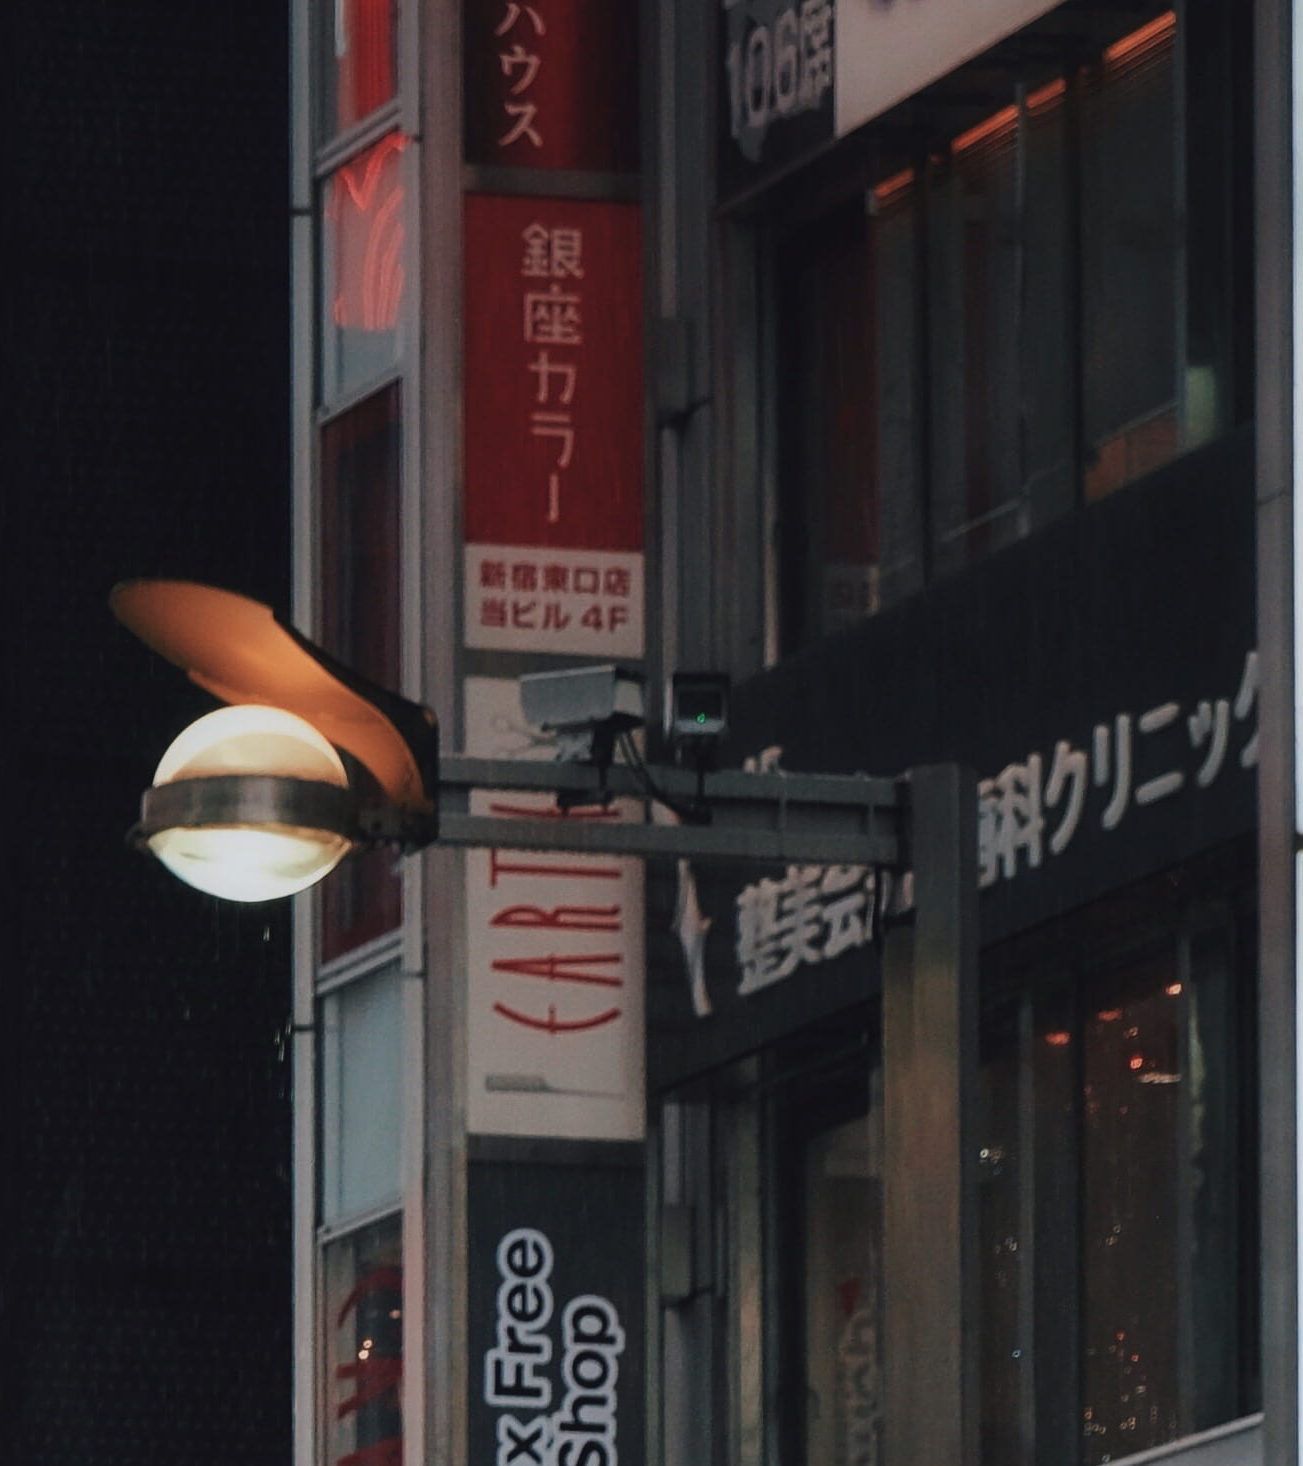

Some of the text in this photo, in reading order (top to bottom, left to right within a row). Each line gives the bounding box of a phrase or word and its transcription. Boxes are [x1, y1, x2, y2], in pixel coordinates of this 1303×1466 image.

[520, 222, 585, 523] 銀座カラー
[478, 557, 632, 597] 新宿東口店
[487, 1229, 553, 1405] Free
